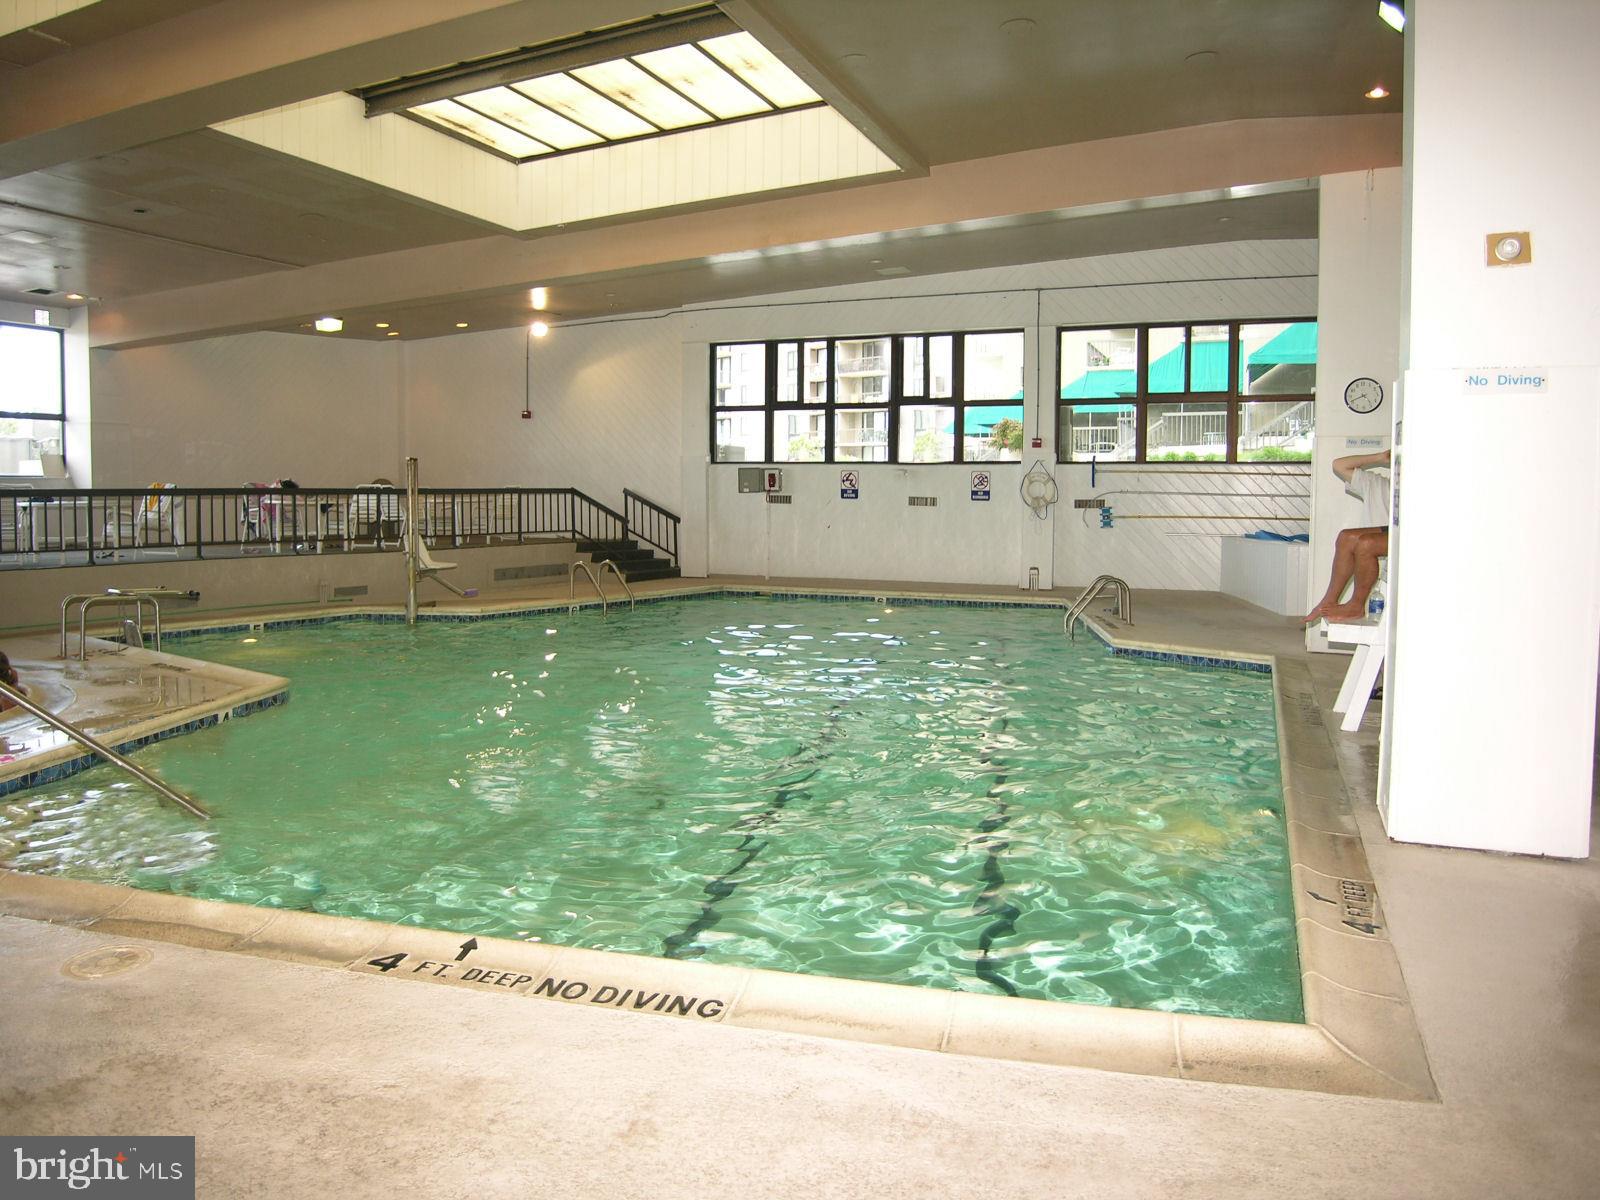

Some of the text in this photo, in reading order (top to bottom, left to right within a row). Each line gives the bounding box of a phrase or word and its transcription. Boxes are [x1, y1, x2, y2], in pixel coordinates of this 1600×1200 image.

[1468, 374, 1542, 387] No Diving
[1341, 920, 1382, 934] 4
[367, 952, 532, 988] 4 FT. DEEP
[533, 977, 724, 1018] NO DIVING
